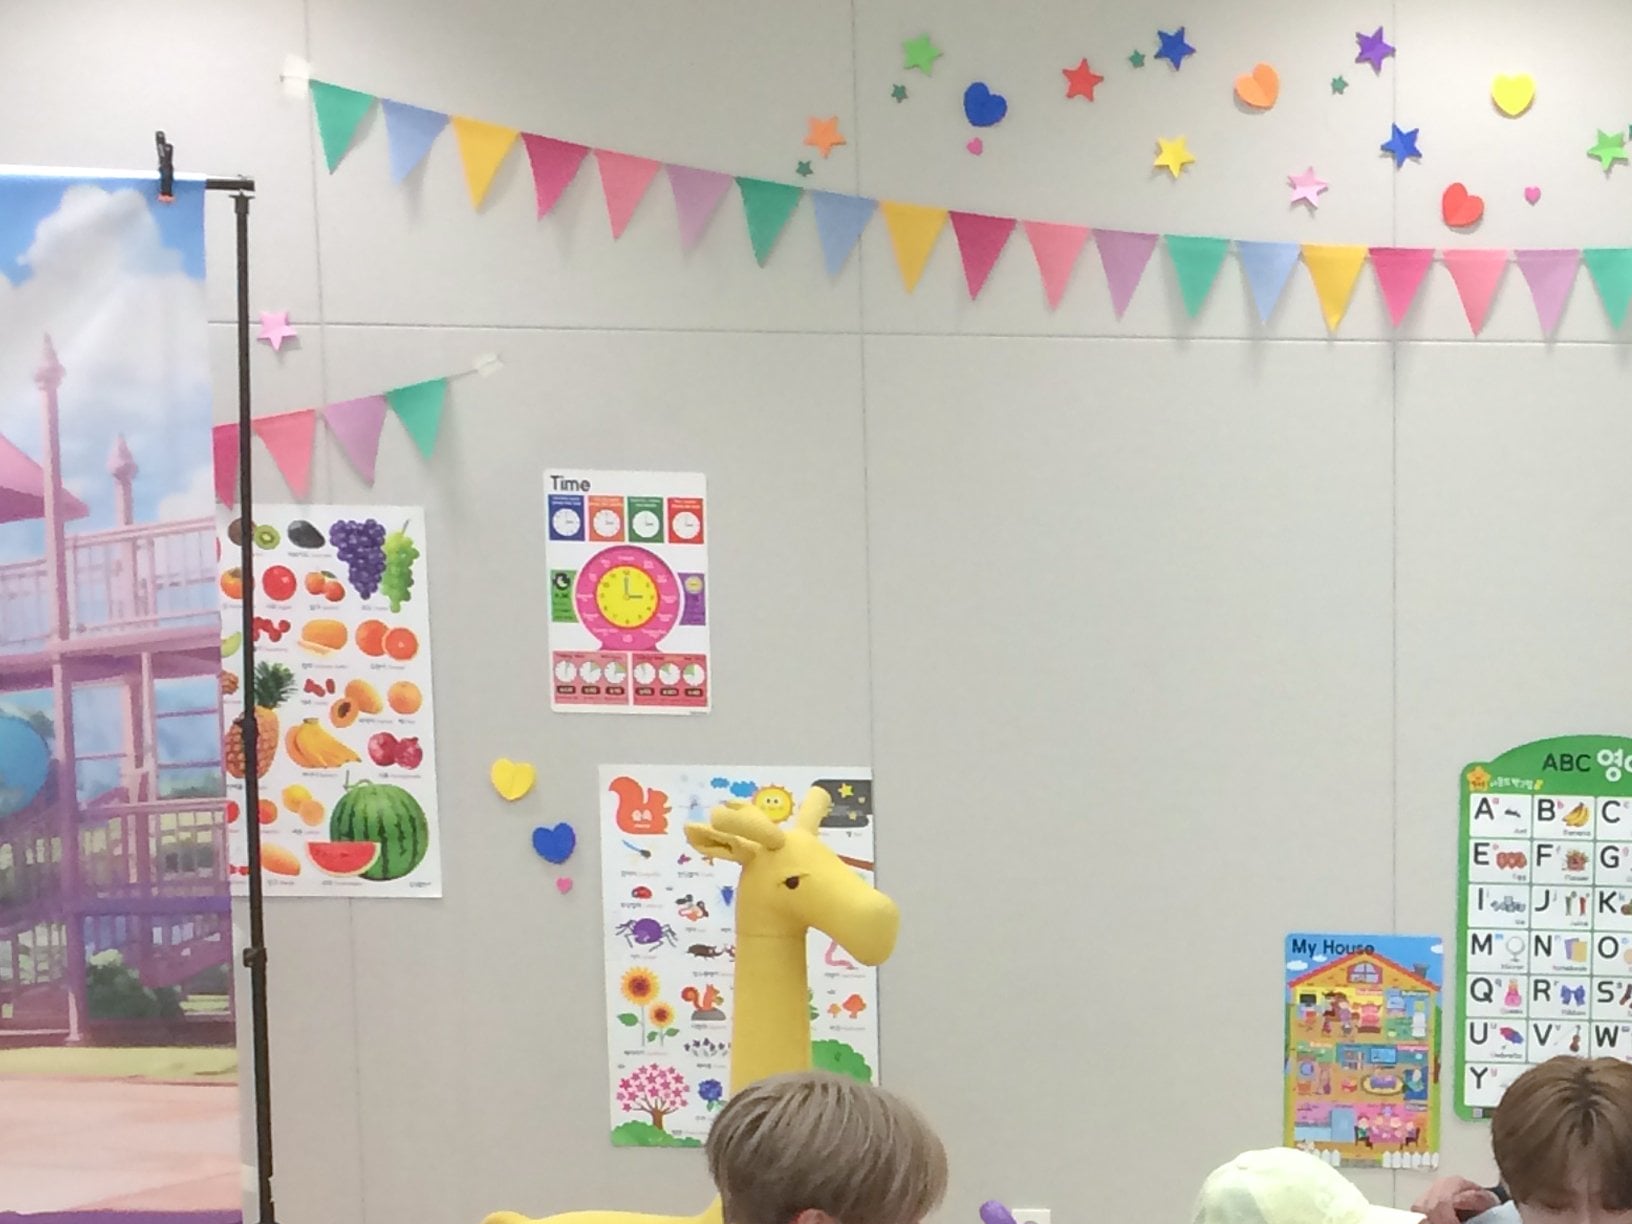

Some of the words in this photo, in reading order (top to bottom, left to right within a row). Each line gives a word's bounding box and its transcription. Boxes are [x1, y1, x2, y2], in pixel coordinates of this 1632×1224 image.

[550, 475, 590, 492] Time
[1542, 754, 1591, 772] ABC
[1474, 797, 1494, 820] A
[1537, 799, 1555, 821] B
[1602, 800, 1620, 823] C
[1474, 843, 1490, 865] E
[1536, 844, 1553, 866] F
[1600, 845, 1619, 869] G
[1479, 888, 1483, 910] I
[1535, 890, 1550, 911] J
[1599, 891, 1617, 913] K
[1292, 939, 1317, 958] My
[1323, 940, 1374, 956] House
[1471, 933, 1492, 955] M
[1534, 935, 1552, 957] N
[1598, 936, 1619, 958] O
[1471, 977, 1493, 1003] Q
[1533, 979, 1550, 1001] R
[1598, 981, 1614, 1002] S
[1470, 1022, 1488, 1044] U
[1534, 1024, 1552, 1046] V
[1595, 1026, 1618, 1047] W
[1470, 1067, 1488, 1089] Y
